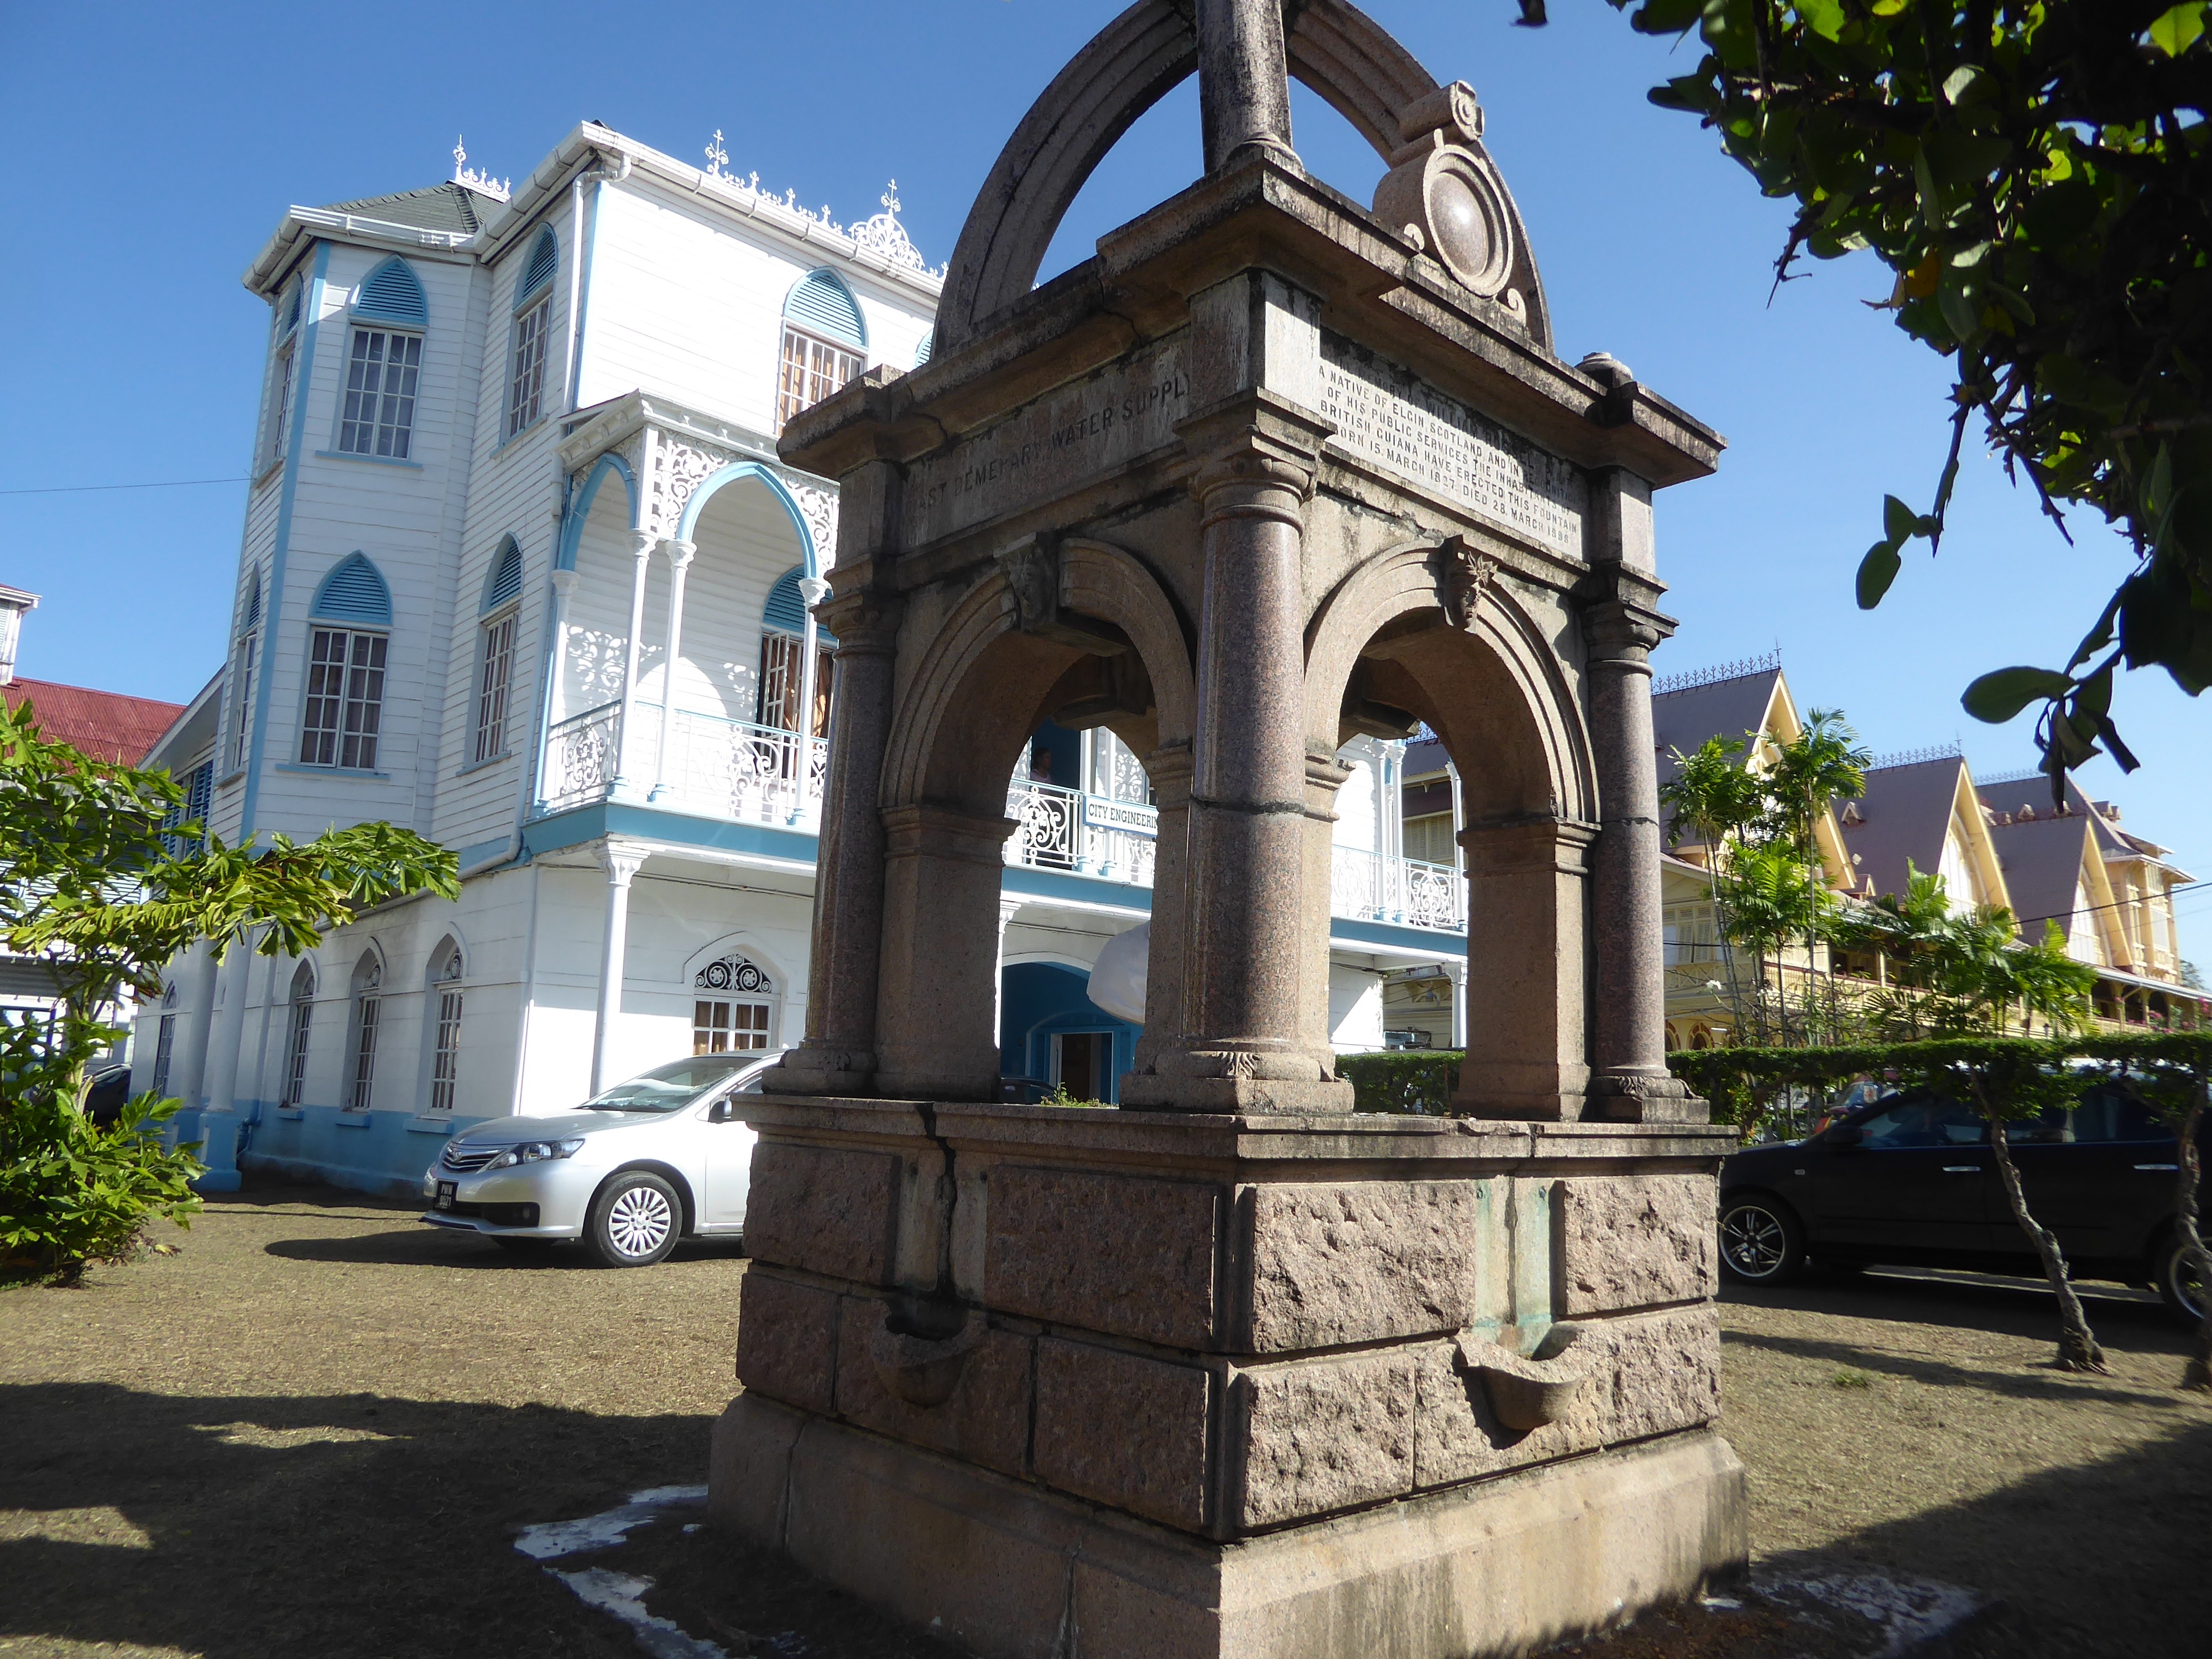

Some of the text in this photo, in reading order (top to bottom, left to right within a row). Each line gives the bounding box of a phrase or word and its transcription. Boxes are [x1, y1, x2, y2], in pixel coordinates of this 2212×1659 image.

[1052, 406, 1113, 451] WATER
[1318, 364, 1326, 379] A
[1329, 369, 1370, 400] NATIVE
[1374, 393, 1388, 409] OF
[1488, 451, 1506, 470] AND
[1327, 386, 1342, 402] OF
[1347, 395, 1366, 416] HIS
[1371, 408, 1412, 437] PUBLIC
[1416, 431, 1469, 465] SERVICES
[1473, 458, 1491, 479] THE
[1320, 399, 1577, 534] BRITISH GUIANA HAVE ERECTED THIS FOUNTAIN
[1386, 447, 1425, 476] MARCH
[1462, 484, 1488, 505] DIED
[1510, 507, 1544, 532] MARCH
[1088, 803, 1108, 819] CITY
